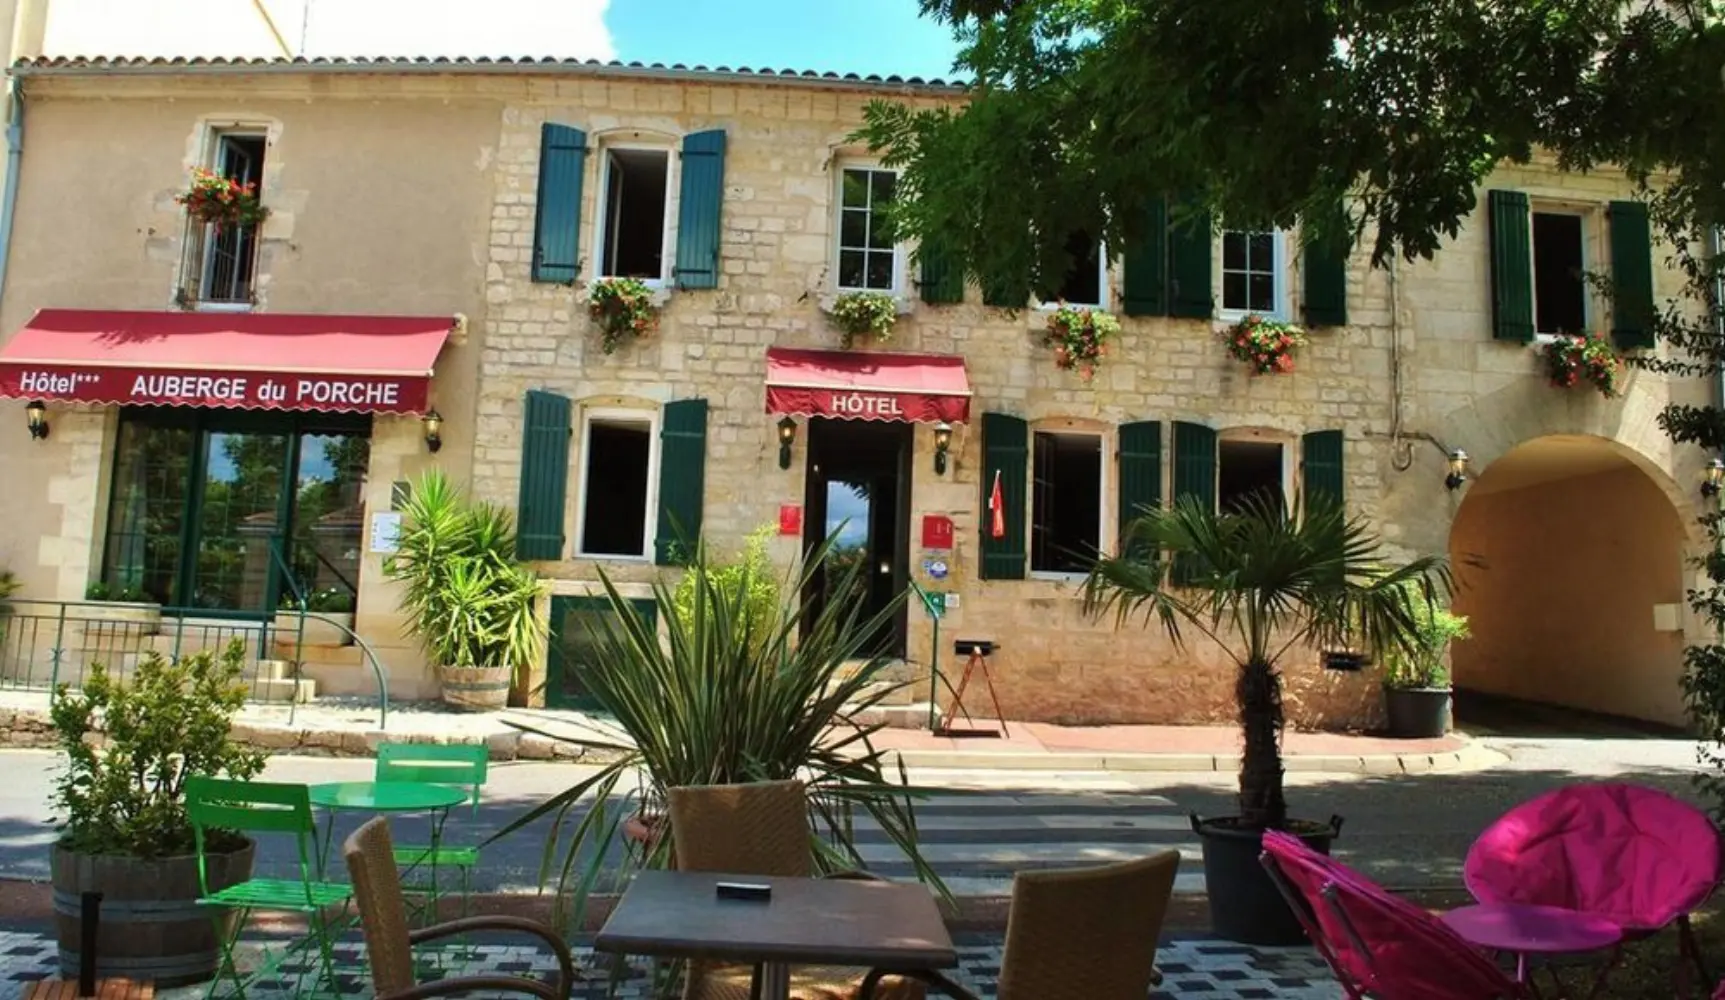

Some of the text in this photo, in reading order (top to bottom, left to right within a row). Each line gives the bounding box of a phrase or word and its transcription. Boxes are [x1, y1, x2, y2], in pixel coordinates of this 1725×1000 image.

[130, 375, 400, 404] AUBERGE du PORCHE
[831, 392, 904, 415] HÔTEL
